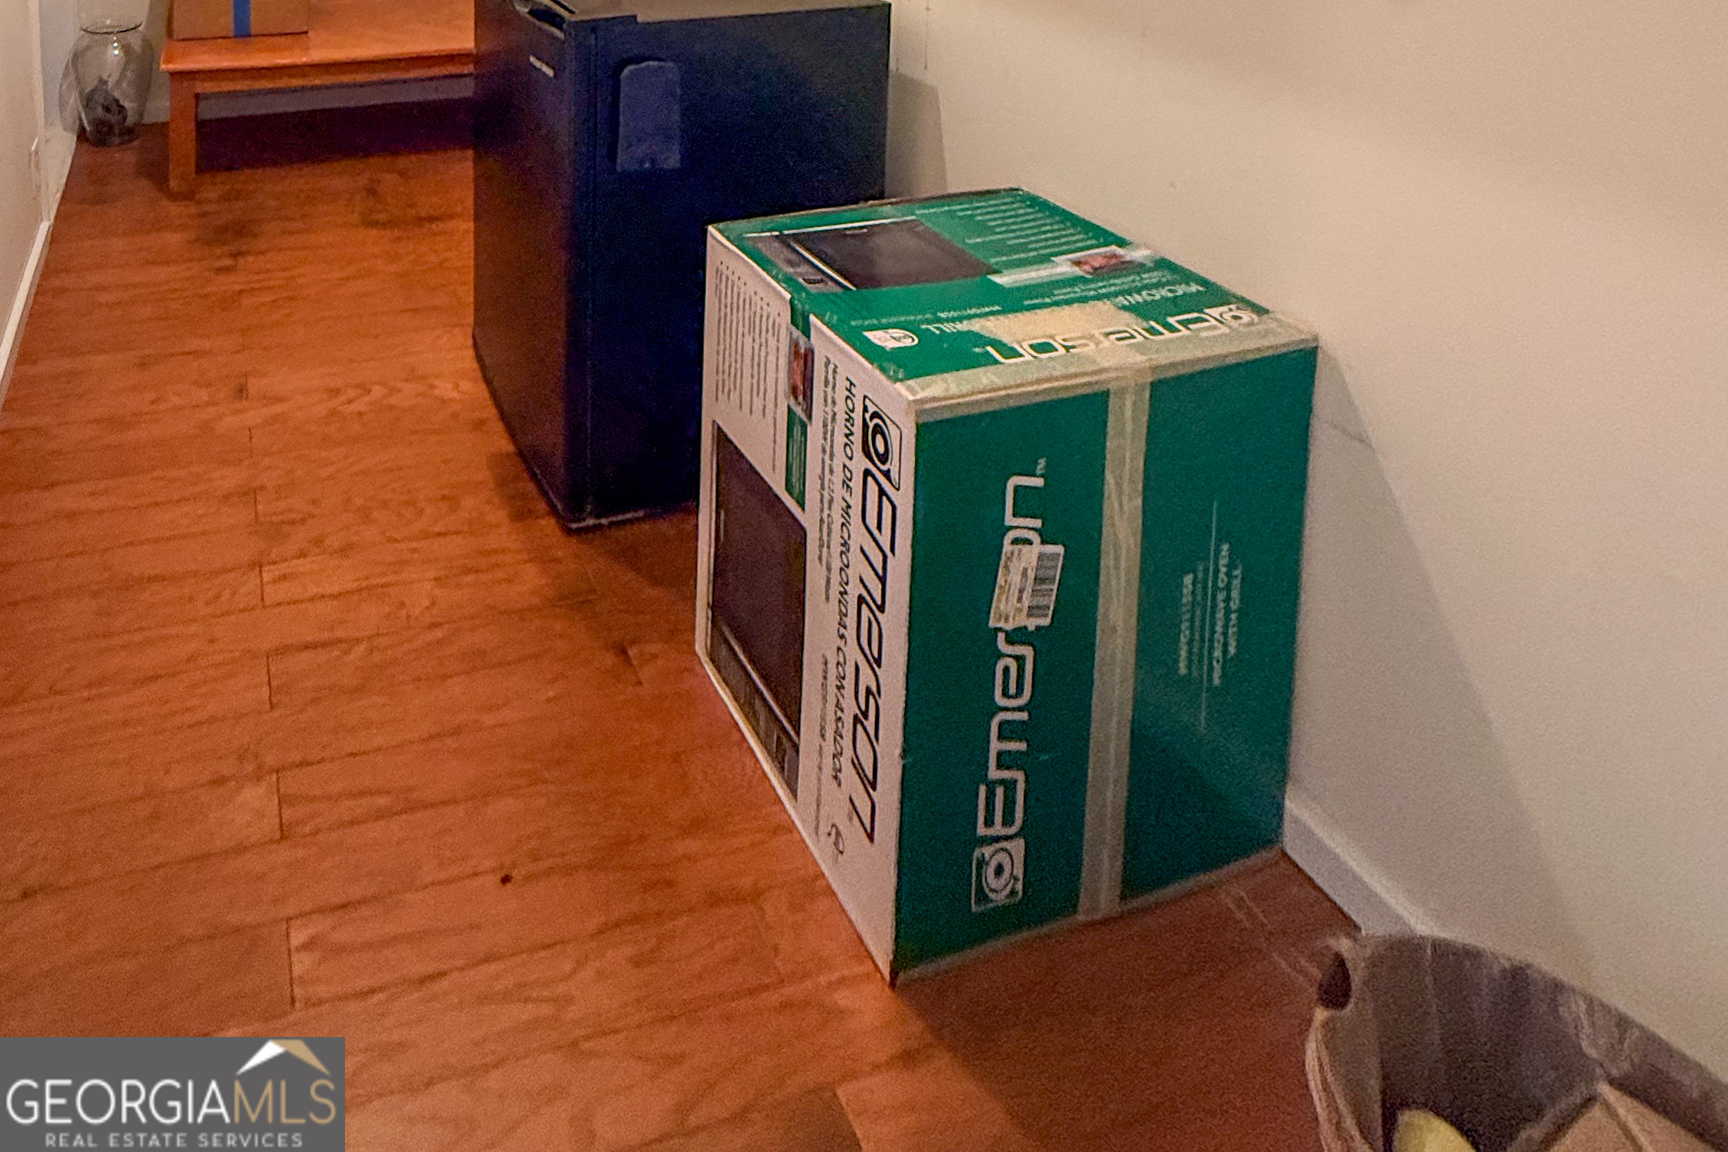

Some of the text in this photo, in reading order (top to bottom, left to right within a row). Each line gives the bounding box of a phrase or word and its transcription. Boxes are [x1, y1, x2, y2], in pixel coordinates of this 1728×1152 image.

[842, 376, 857, 461] HORNO
[841, 462, 855, 497] DE
[836, 498, 853, 645] MICROONDAS
[1217, 542, 1230, 588] OVEN
[849, 468, 898, 845] Emerson
[977, 474, 1045, 838] Emern
